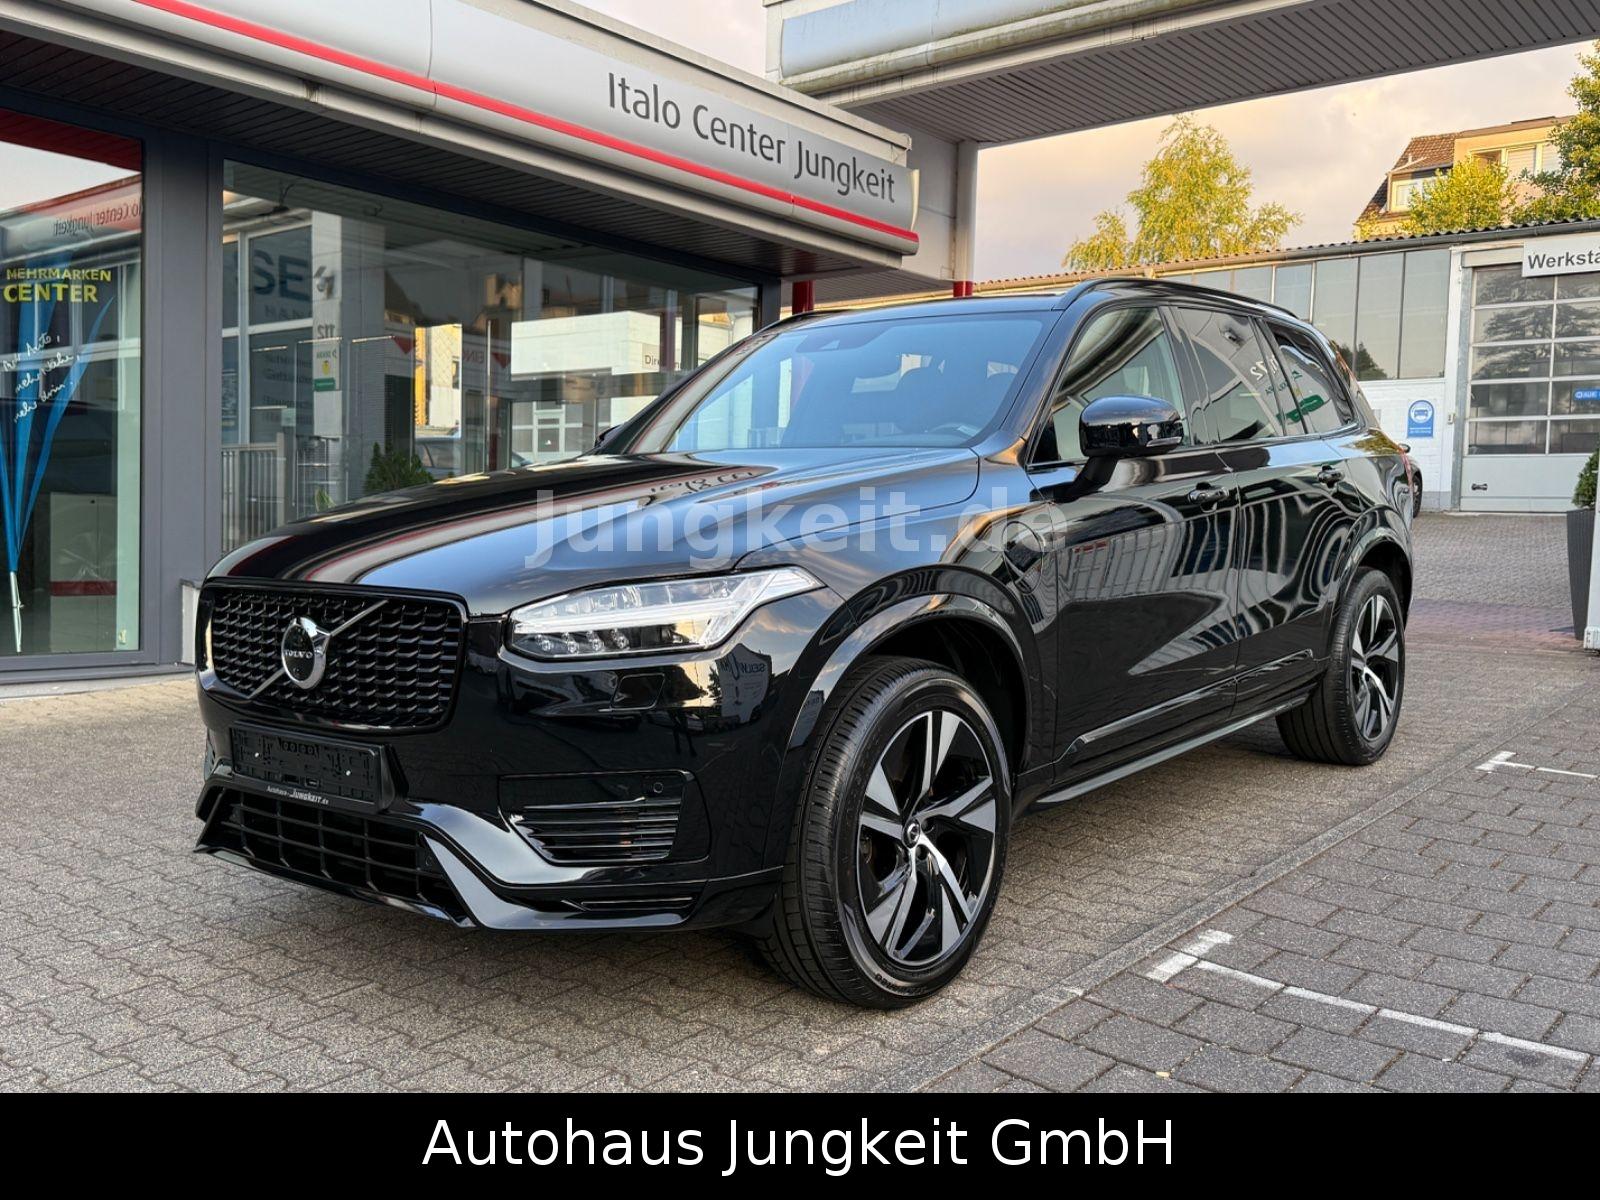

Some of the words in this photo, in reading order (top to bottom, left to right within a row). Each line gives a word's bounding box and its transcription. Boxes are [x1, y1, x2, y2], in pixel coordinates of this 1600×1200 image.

[608, 72, 681, 129] Italo
[693, 104, 785, 164] Center
[793, 140, 895, 203] Jungkeit
[6, 267, 112, 282] MEHRMARKEN
[3, 283, 98, 303] CENTER
[283, 649, 313, 659] VOLVO
